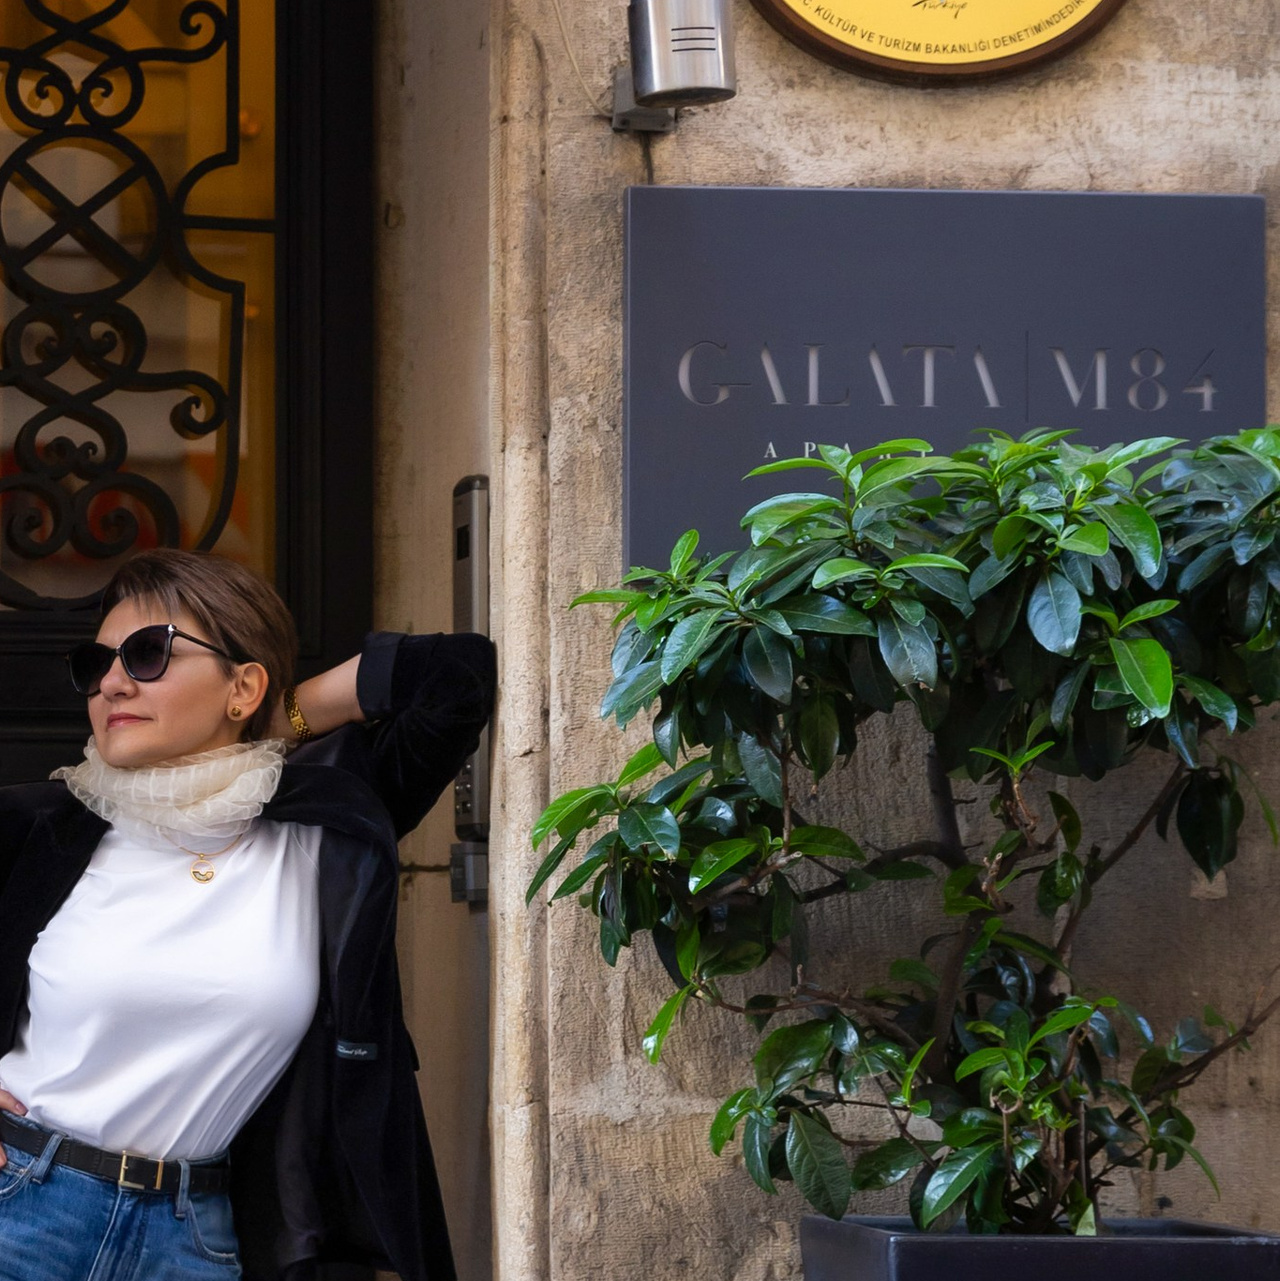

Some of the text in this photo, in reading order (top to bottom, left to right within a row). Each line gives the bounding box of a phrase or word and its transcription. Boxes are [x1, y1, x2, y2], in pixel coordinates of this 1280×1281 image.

[814, 5, 859, 36] KÜLTÜR
[860, 29, 875, 43] VE
[878, 35, 922, 53] TURİZM
[925, 39, 991, 54] BAKANLIĞI
[677, 339, 1219, 413] GALATA M84
